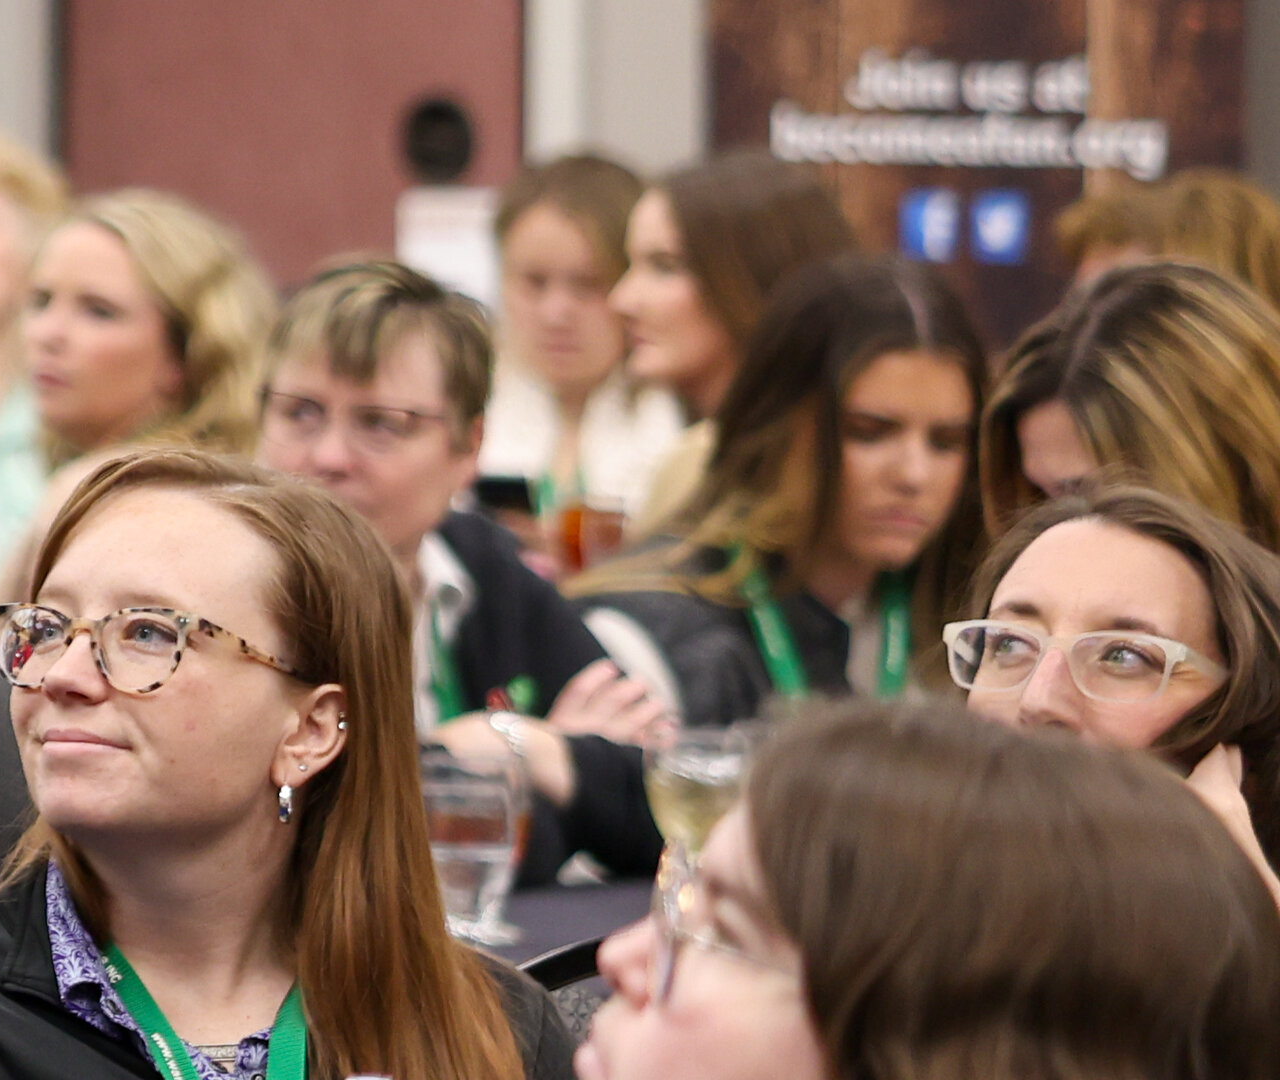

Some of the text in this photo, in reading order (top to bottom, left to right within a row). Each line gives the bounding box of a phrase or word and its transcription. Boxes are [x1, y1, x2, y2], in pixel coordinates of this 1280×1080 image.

[847, 49, 958, 110] Join
[963, 60, 1029, 112] us
[105, 965, 123, 984] INC
